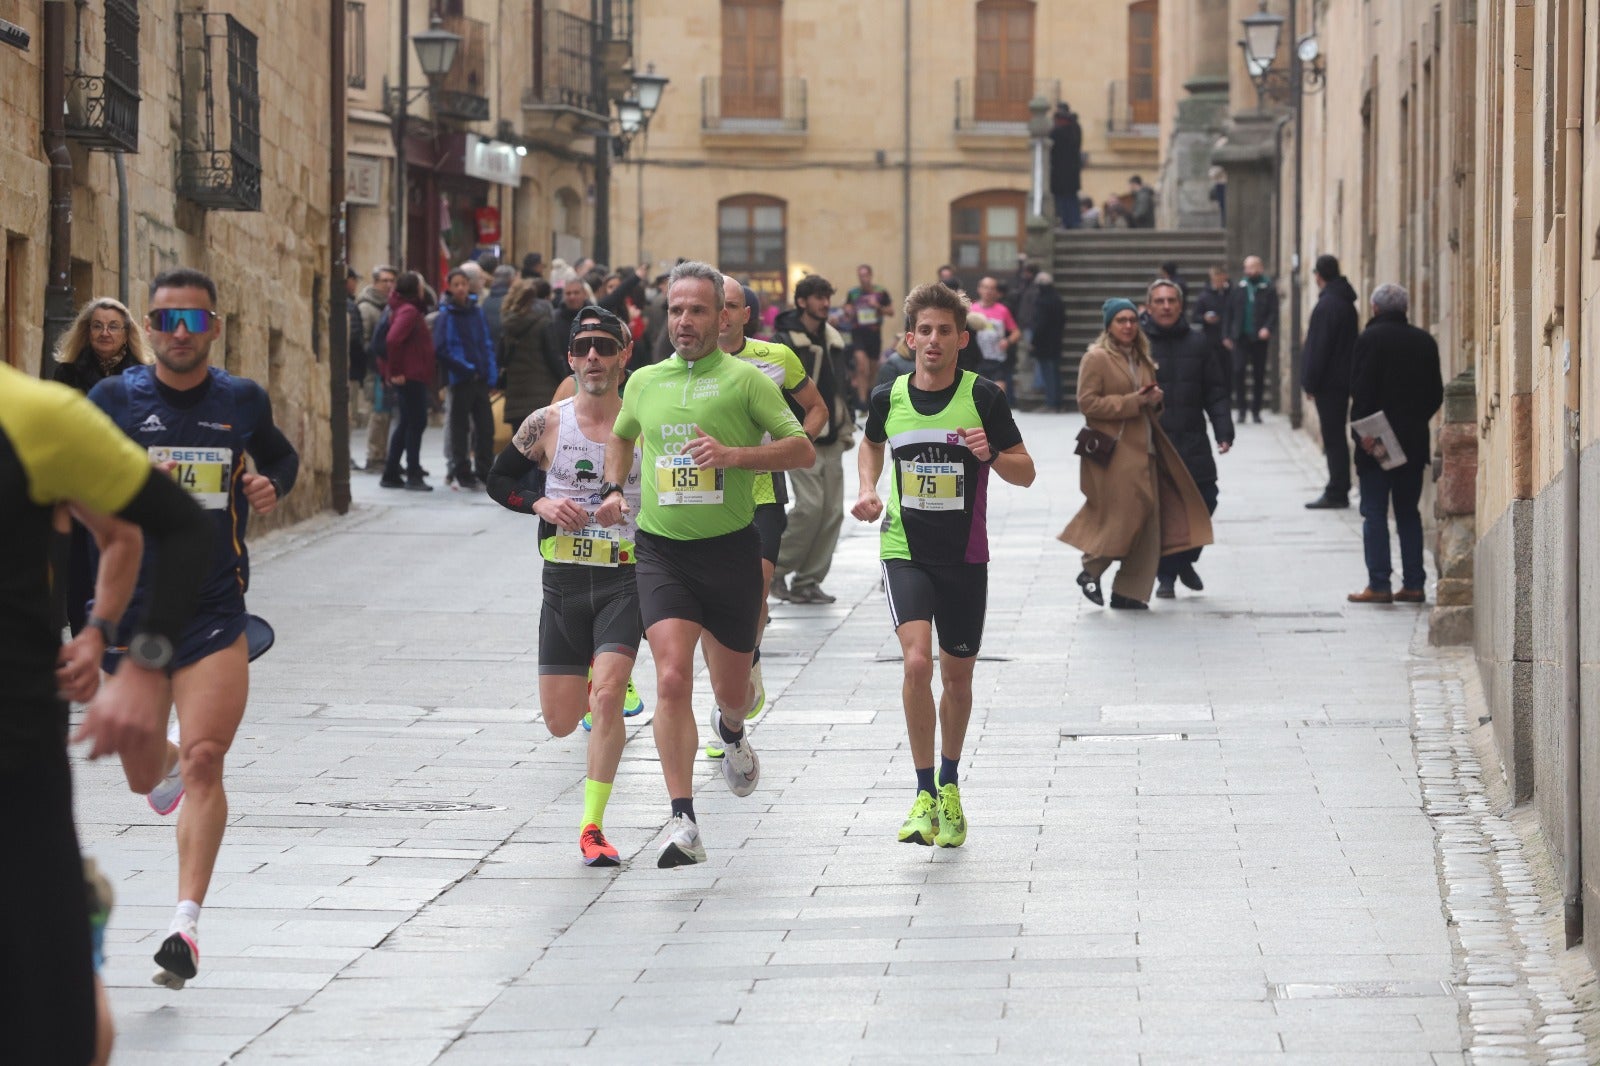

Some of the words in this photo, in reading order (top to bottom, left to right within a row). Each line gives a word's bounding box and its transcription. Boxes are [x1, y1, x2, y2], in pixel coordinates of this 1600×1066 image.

[172, 451, 224, 462] SETEL
[177, 464, 196, 487] 14
[672, 467, 699, 487] 135
[916, 465, 957, 474] SETEL
[917, 475, 937, 494] 75
[573, 529, 613, 540] SETEL
[572, 538, 593, 558] 59
